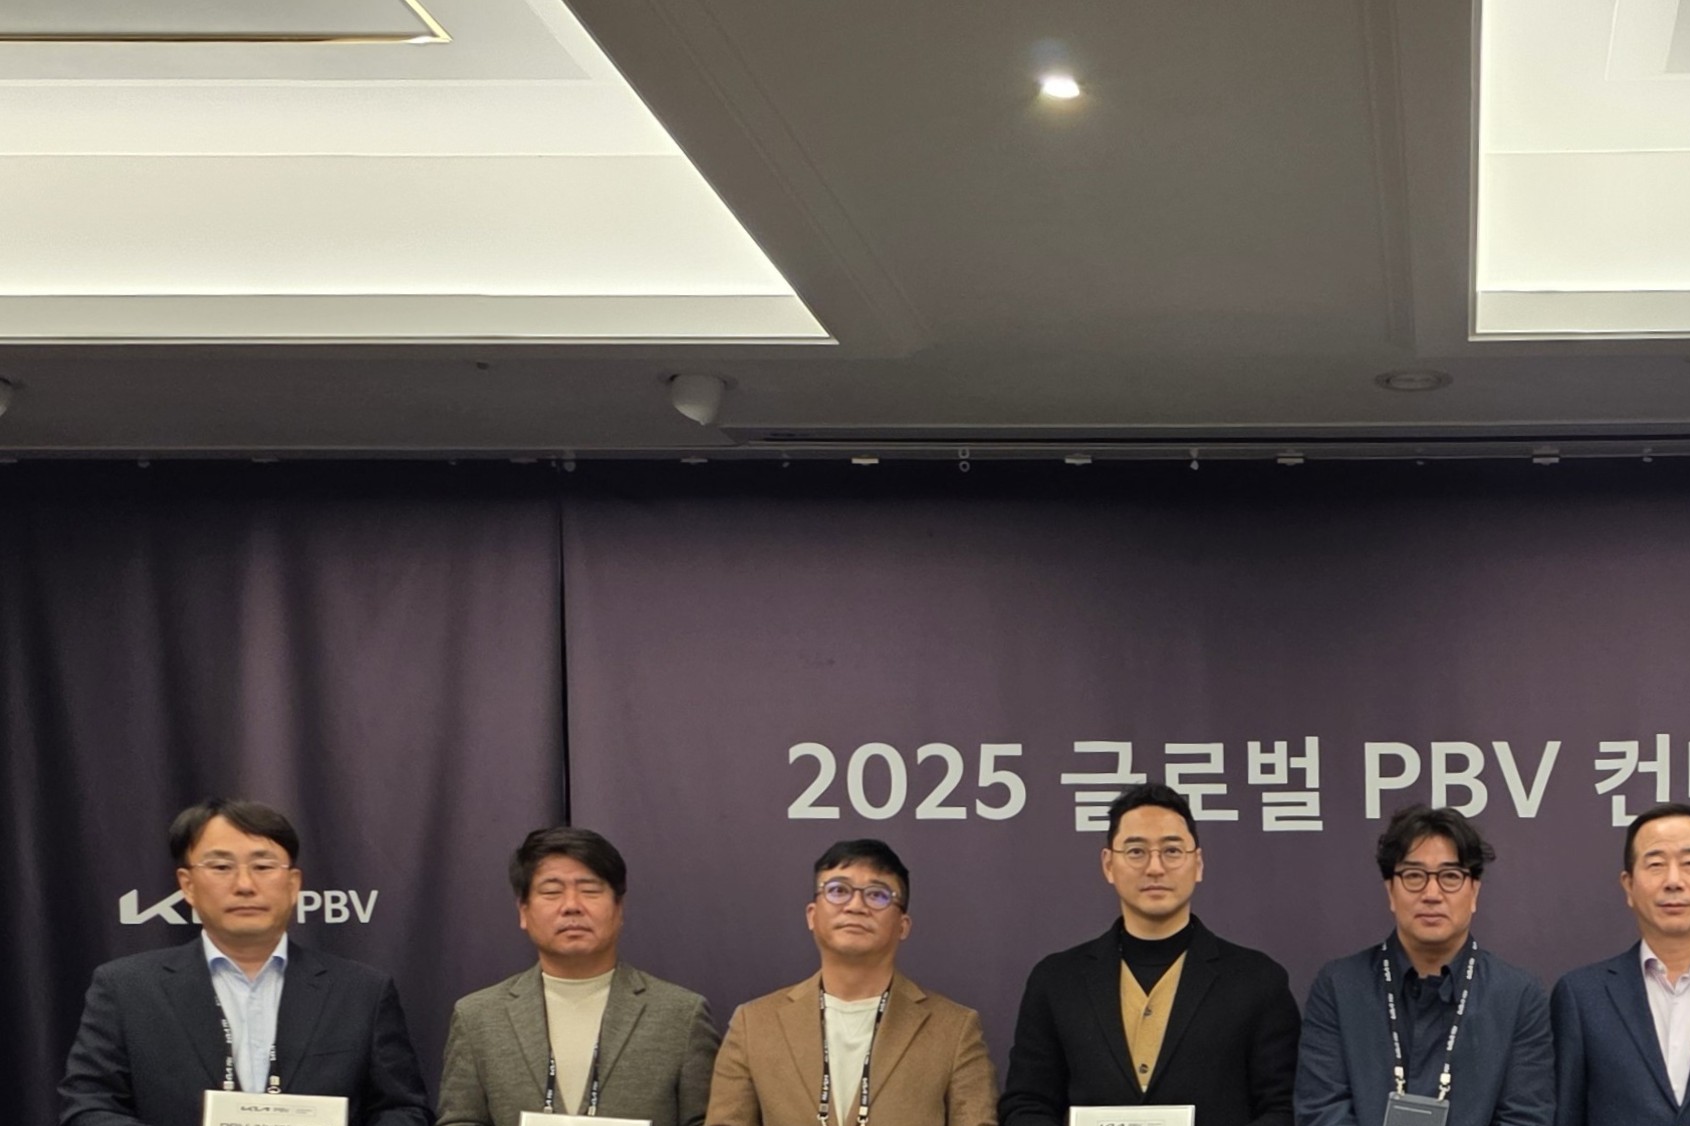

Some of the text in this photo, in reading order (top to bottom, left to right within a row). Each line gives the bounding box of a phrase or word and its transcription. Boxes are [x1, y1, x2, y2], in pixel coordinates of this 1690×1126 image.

[786, 741, 1029, 820] 2025
[1364, 741, 1561, 820] PBV
[297, 889, 379, 924] PBV
